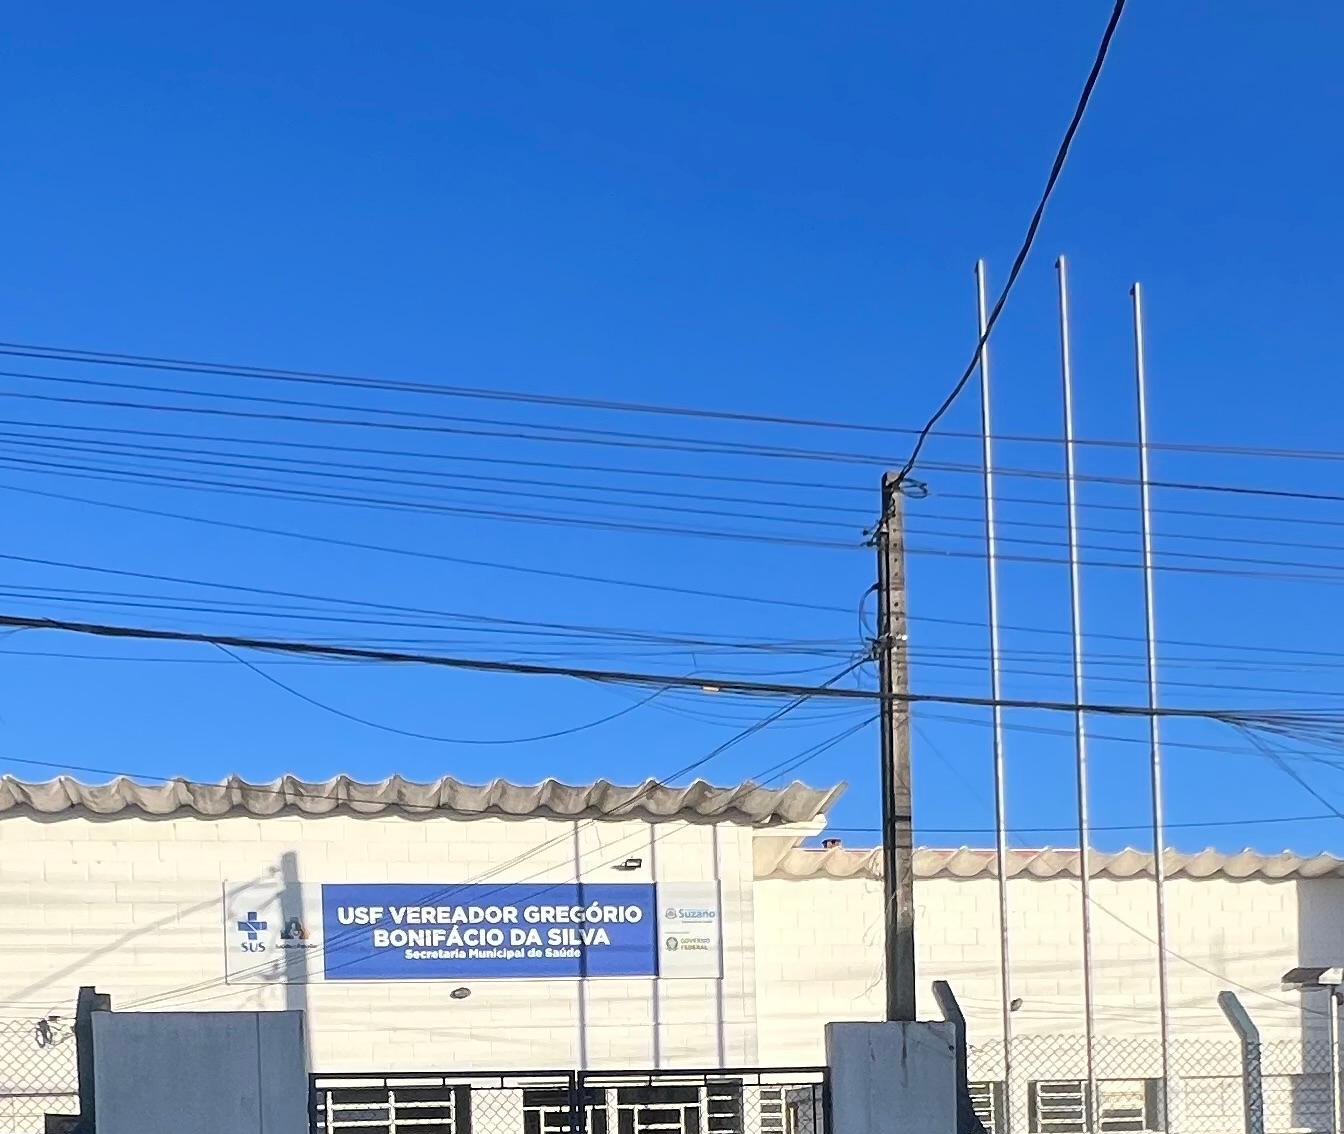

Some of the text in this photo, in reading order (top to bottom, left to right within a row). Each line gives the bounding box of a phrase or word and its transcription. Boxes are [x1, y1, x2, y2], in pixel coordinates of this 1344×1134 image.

[337, 901, 643, 925] USF VEREADOR GREGÓRIO
[678, 908, 716, 919] Suzano
[373, 925, 611, 947] BONIFÁCIO DA SILVA
[240, 942, 266, 953] SUS
[405, 947, 581, 961] Secretaria Municipal de Saúde
